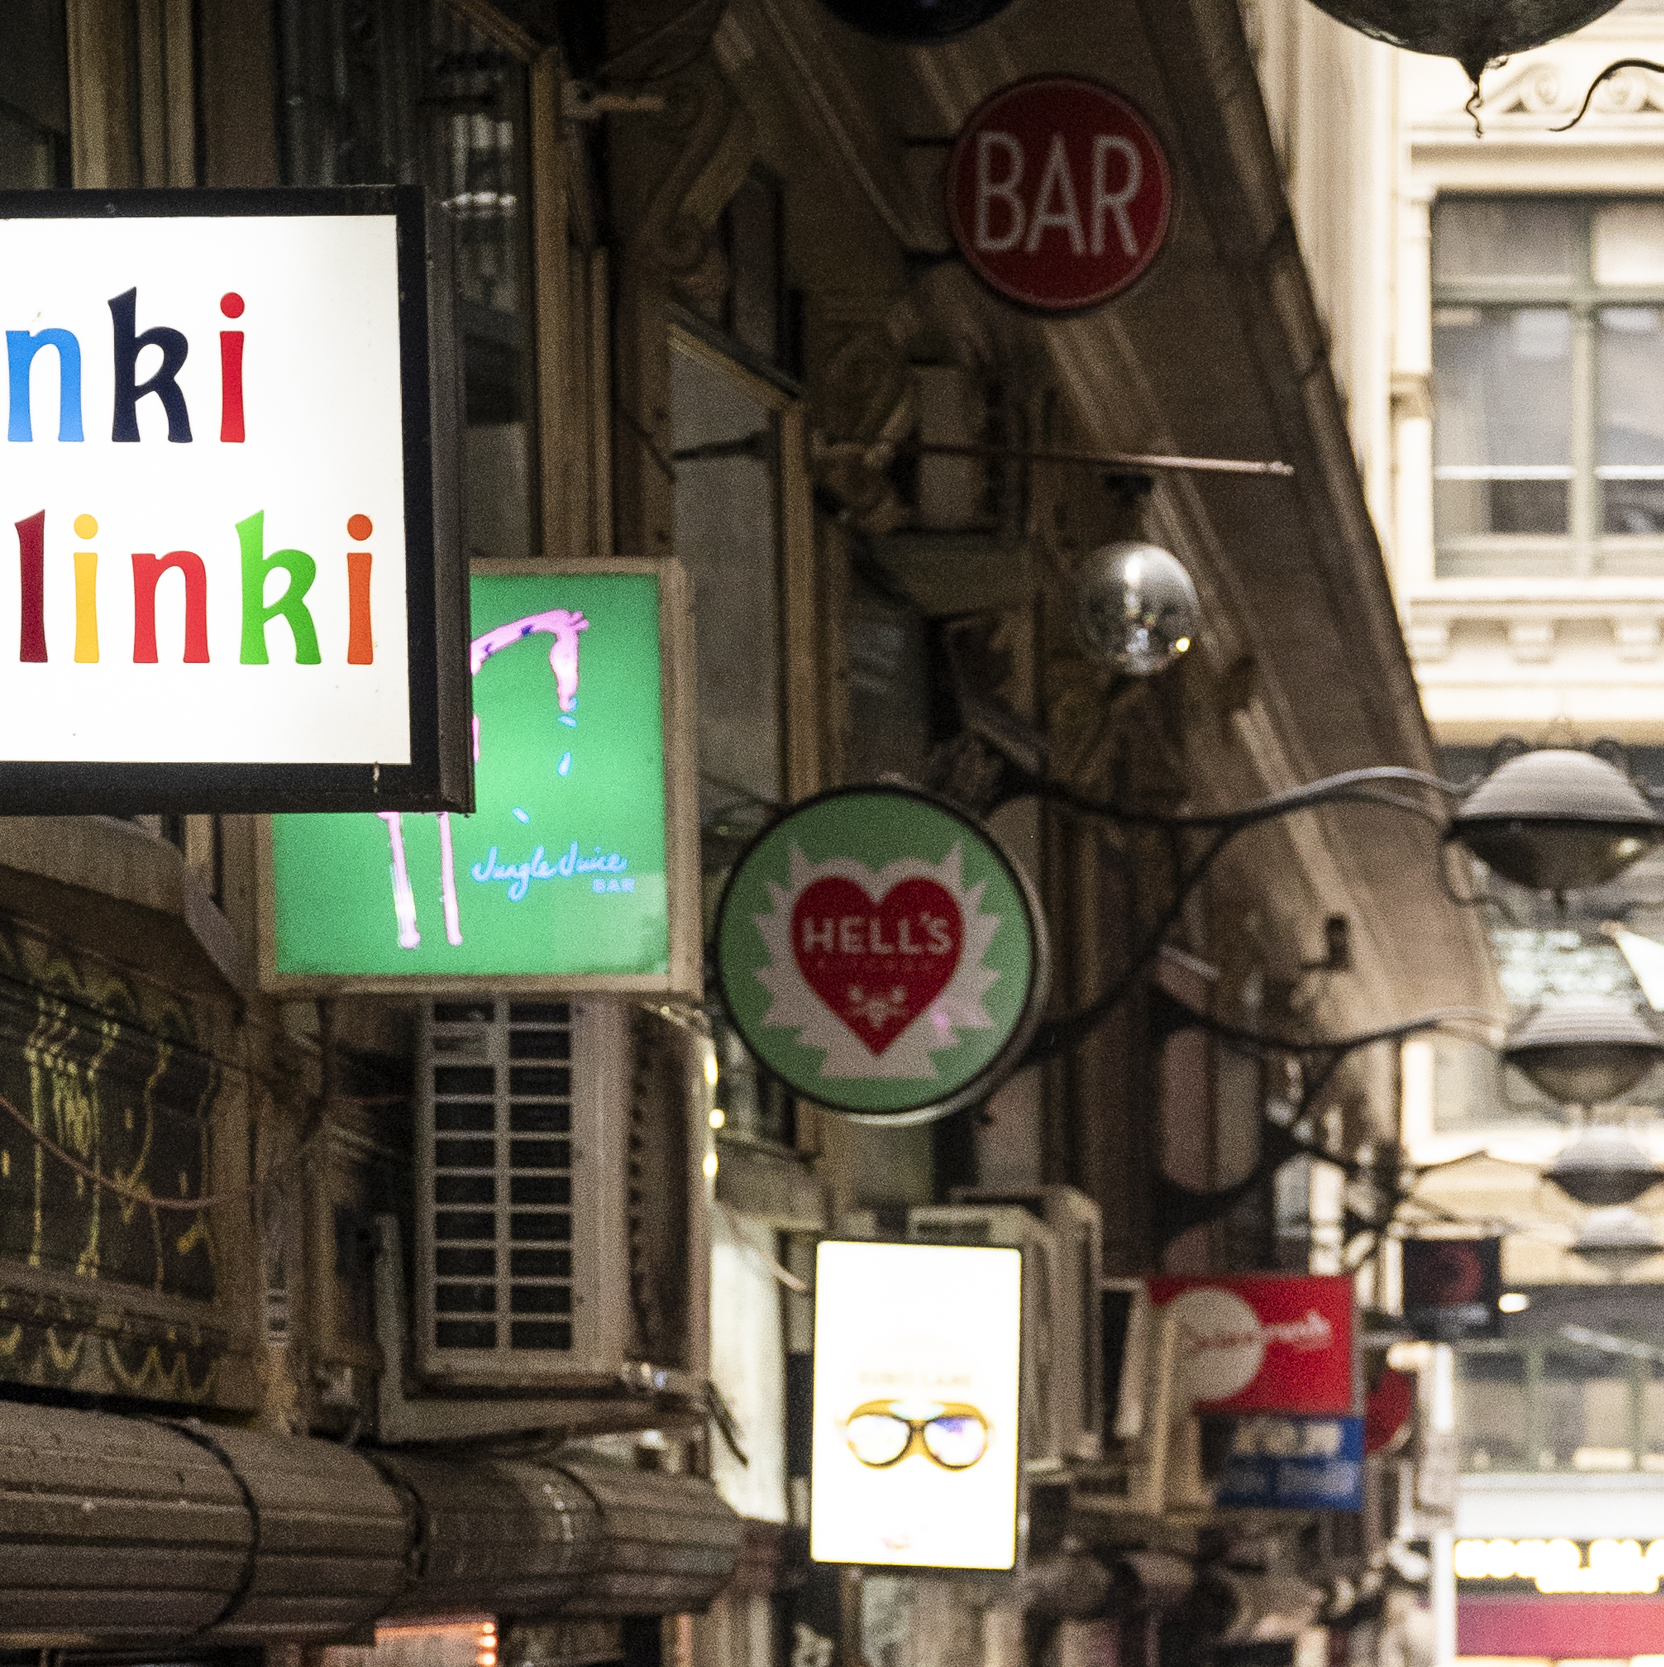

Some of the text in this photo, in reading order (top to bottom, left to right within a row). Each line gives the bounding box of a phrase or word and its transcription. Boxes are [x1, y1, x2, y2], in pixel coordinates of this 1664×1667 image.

[974, 131, 1145, 257] BAR
[5, 286, 246, 443] nki
[591, 877, 636, 894] BAR
[802, 911, 952, 954] HELL'S
